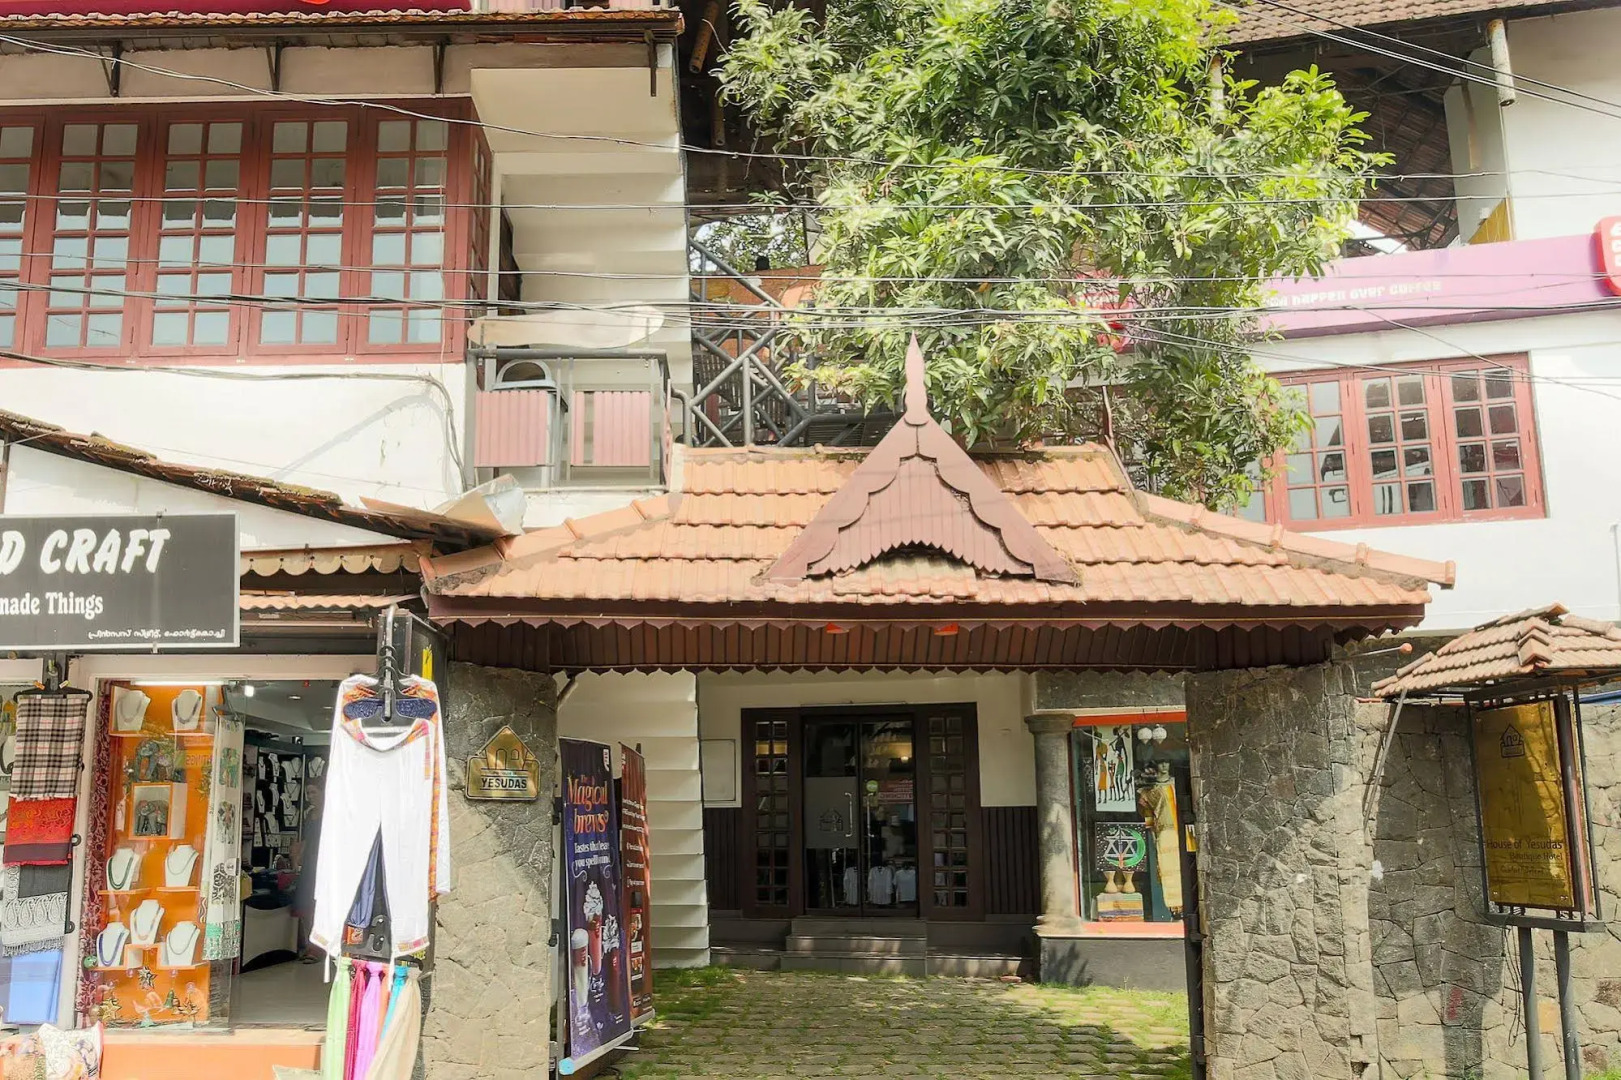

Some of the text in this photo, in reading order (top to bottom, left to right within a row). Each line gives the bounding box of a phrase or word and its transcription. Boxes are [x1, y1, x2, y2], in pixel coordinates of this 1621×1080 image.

[40, 528, 171, 574] CRAFT
[45, 591, 104, 620] Things
[481, 777, 527, 788] YESUDAS
[567, 777, 608, 811] Magical
[574, 808, 607, 834] brews
[1487, 839, 1563, 849] House of Yesudas
[574, 858, 585, 870] you
